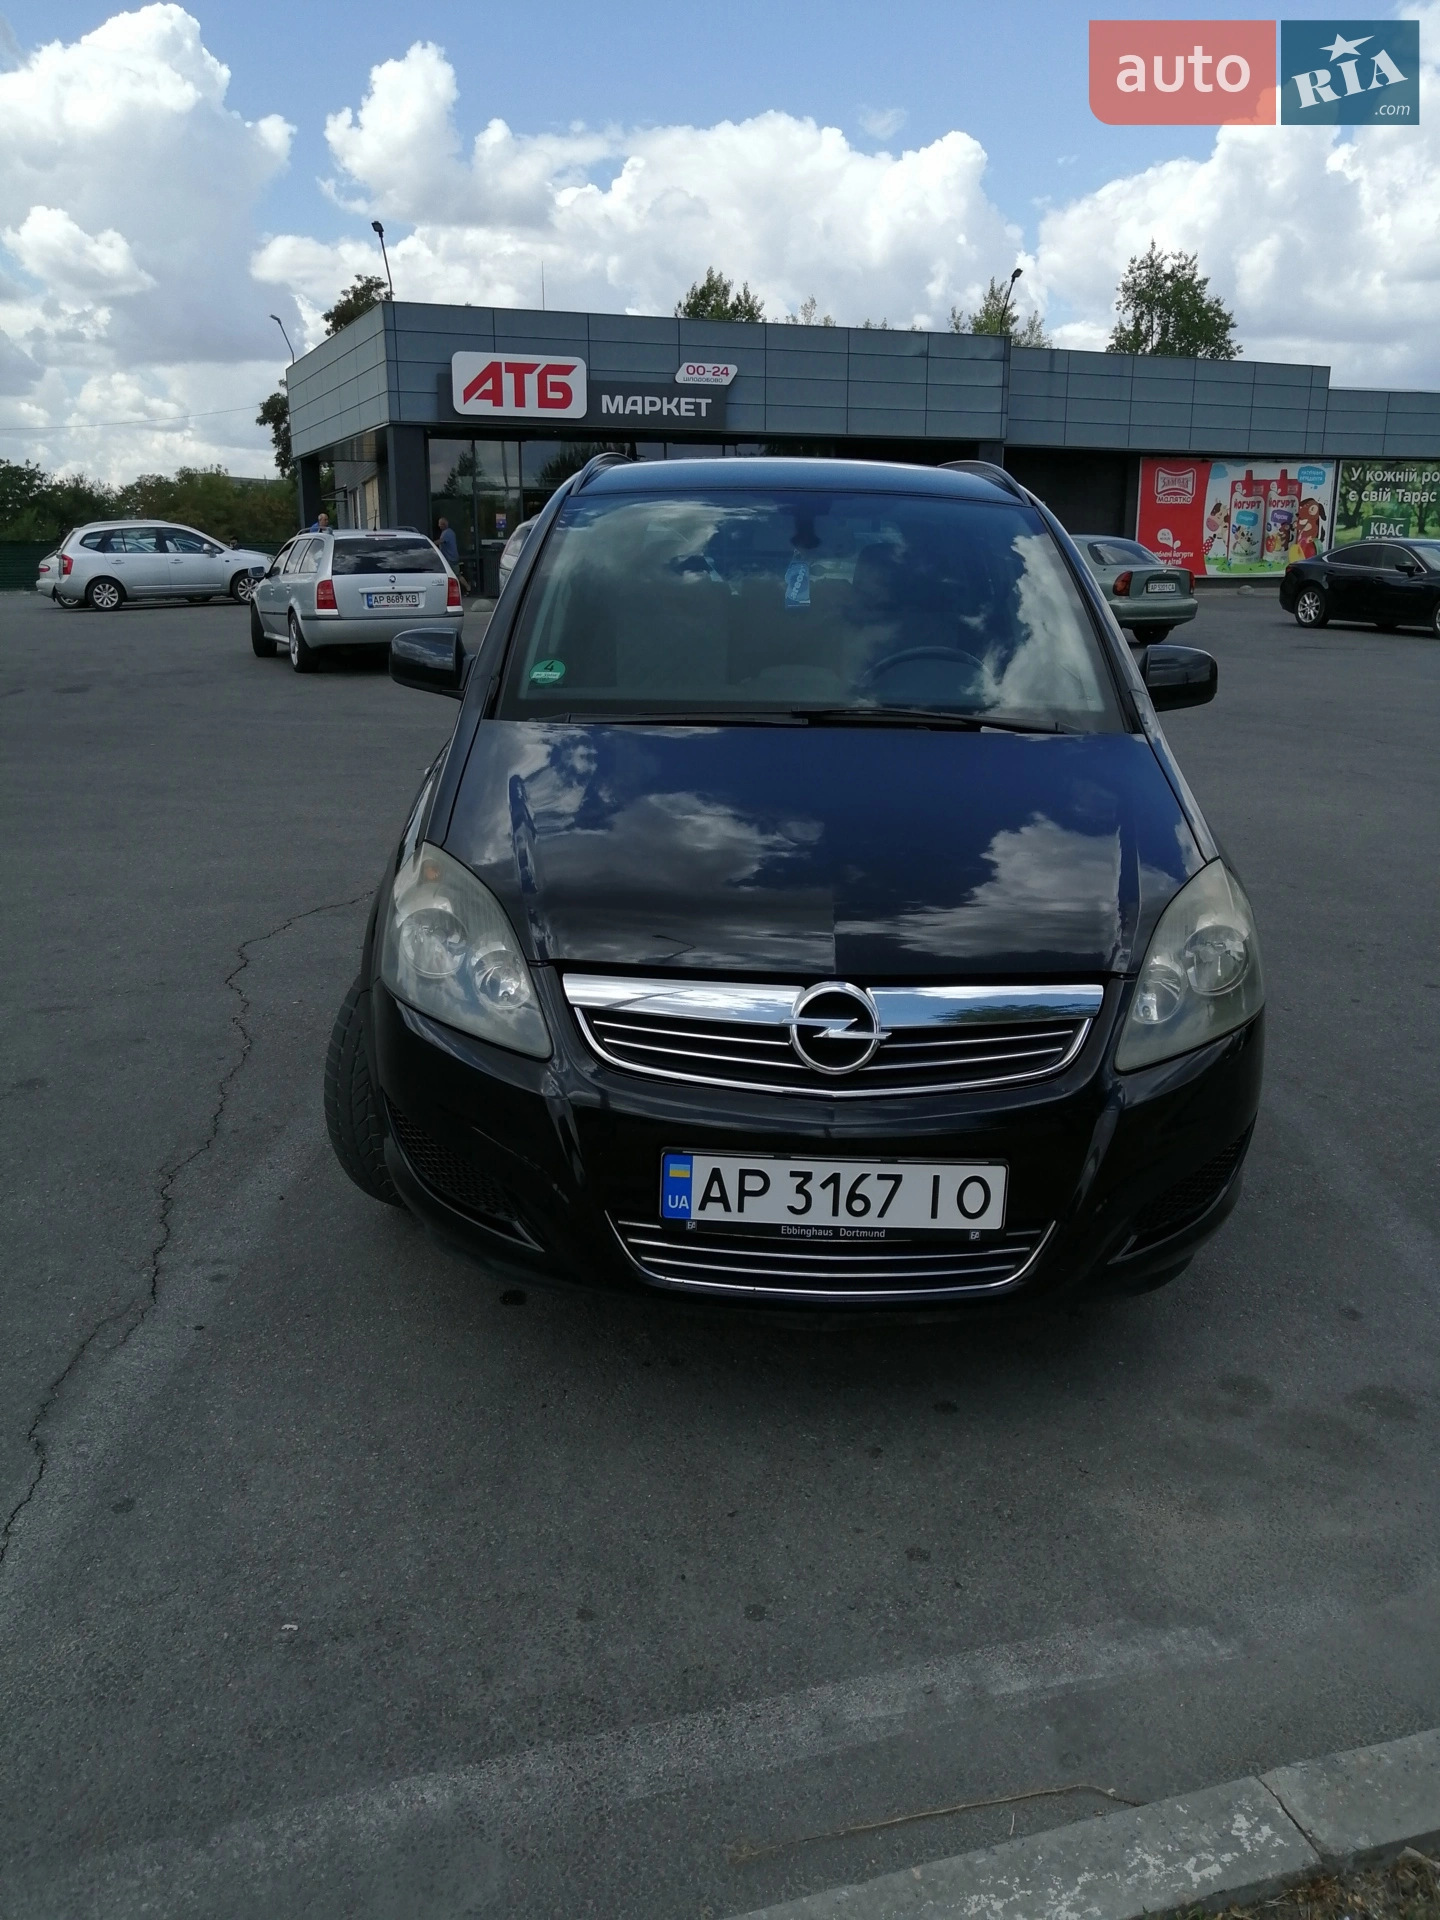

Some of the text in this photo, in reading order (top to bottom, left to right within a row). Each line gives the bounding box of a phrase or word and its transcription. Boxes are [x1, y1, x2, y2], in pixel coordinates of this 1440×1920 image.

[686, 364, 730, 377] 00-24
[463, 361, 578, 409] АТБ
[601, 395, 712, 417] МАРКЕТ
[1365, 467, 1418, 483] кожній
[1361, 487, 1391, 502] свій
[1396, 488, 1437, 506] Тарас
[1370, 522, 1404, 536] КВАС
[373, 595, 384, 604] AP
[543, 660, 555, 672] 4
[698, 1167, 771, 1213] AP
[786, 1170, 903, 1218] 3167
[668, 1194, 689, 1209] UA
[781, 1225, 885, 1238] Ebbinghaus Dortmund
